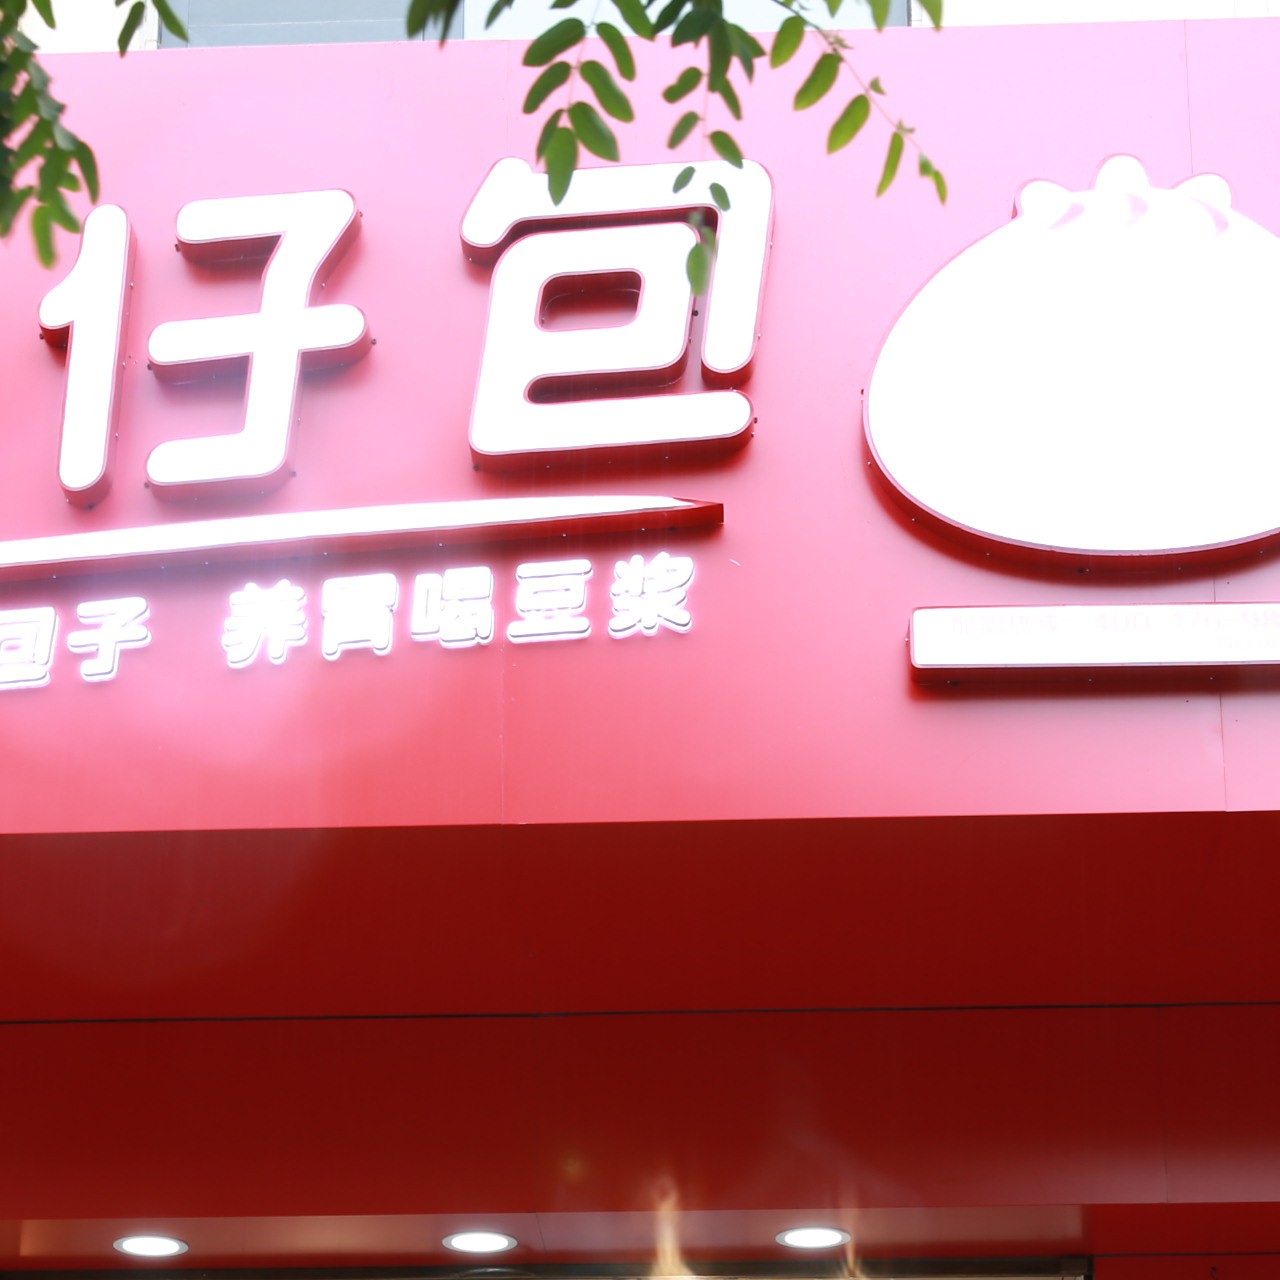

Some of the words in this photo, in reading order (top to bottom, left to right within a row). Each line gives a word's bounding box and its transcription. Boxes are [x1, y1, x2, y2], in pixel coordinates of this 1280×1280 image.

[224, 550, 700, 670] 养胃喝豆浆
